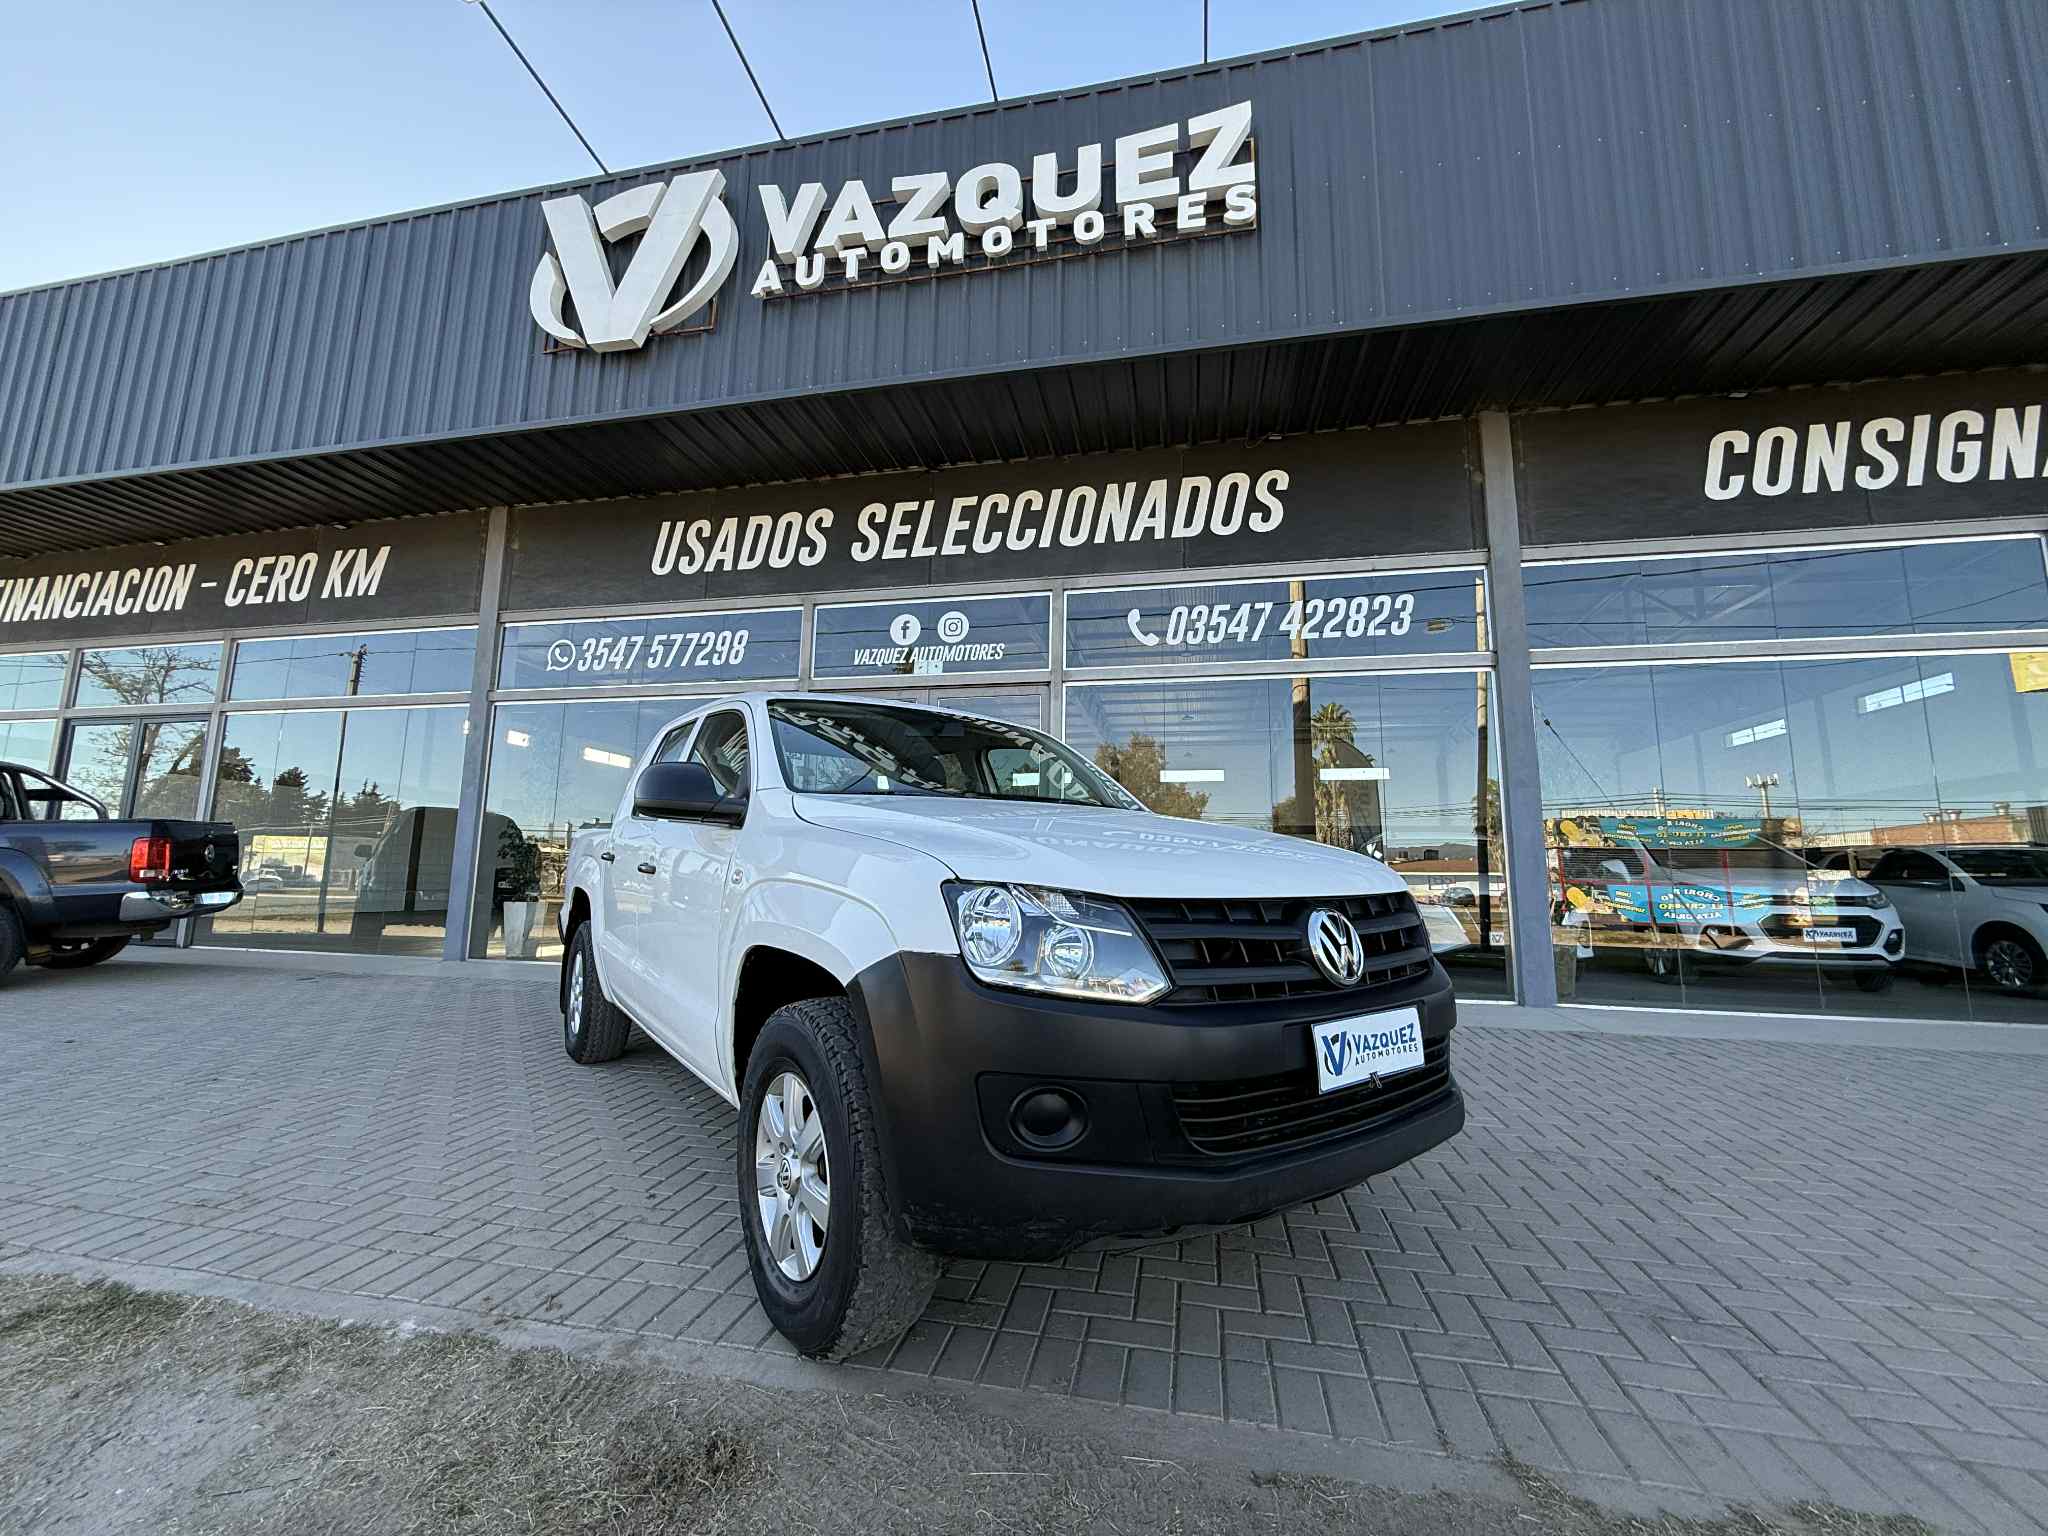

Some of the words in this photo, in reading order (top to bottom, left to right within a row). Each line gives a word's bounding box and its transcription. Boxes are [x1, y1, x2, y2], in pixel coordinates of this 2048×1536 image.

[758, 100, 1256, 264] VAZQUEZ
[751, 183, 1258, 299] AUTOMOTORES
[1704, 405, 2048, 501] CONSIGN
[650, 508, 834, 576] USADOS
[850, 469, 1291, 562] SELECCIONADOS
[224, 552, 319, 607] CERO
[320, 545, 391, 599] KM
[1166, 601, 1273, 646] 03547
[1279, 593, 1415, 640] 422823
[577, 635, 645, 672] 3547
[647, 629, 749, 669] 577298
[853, 649, 908, 666] VAZQUEZ
[910, 643, 1006, 663] AUTOMOTORES
[1352, 1022, 1417, 1054] VAZQUEZ
[1355, 1043, 1418, 1066] AUTOMOTORES
